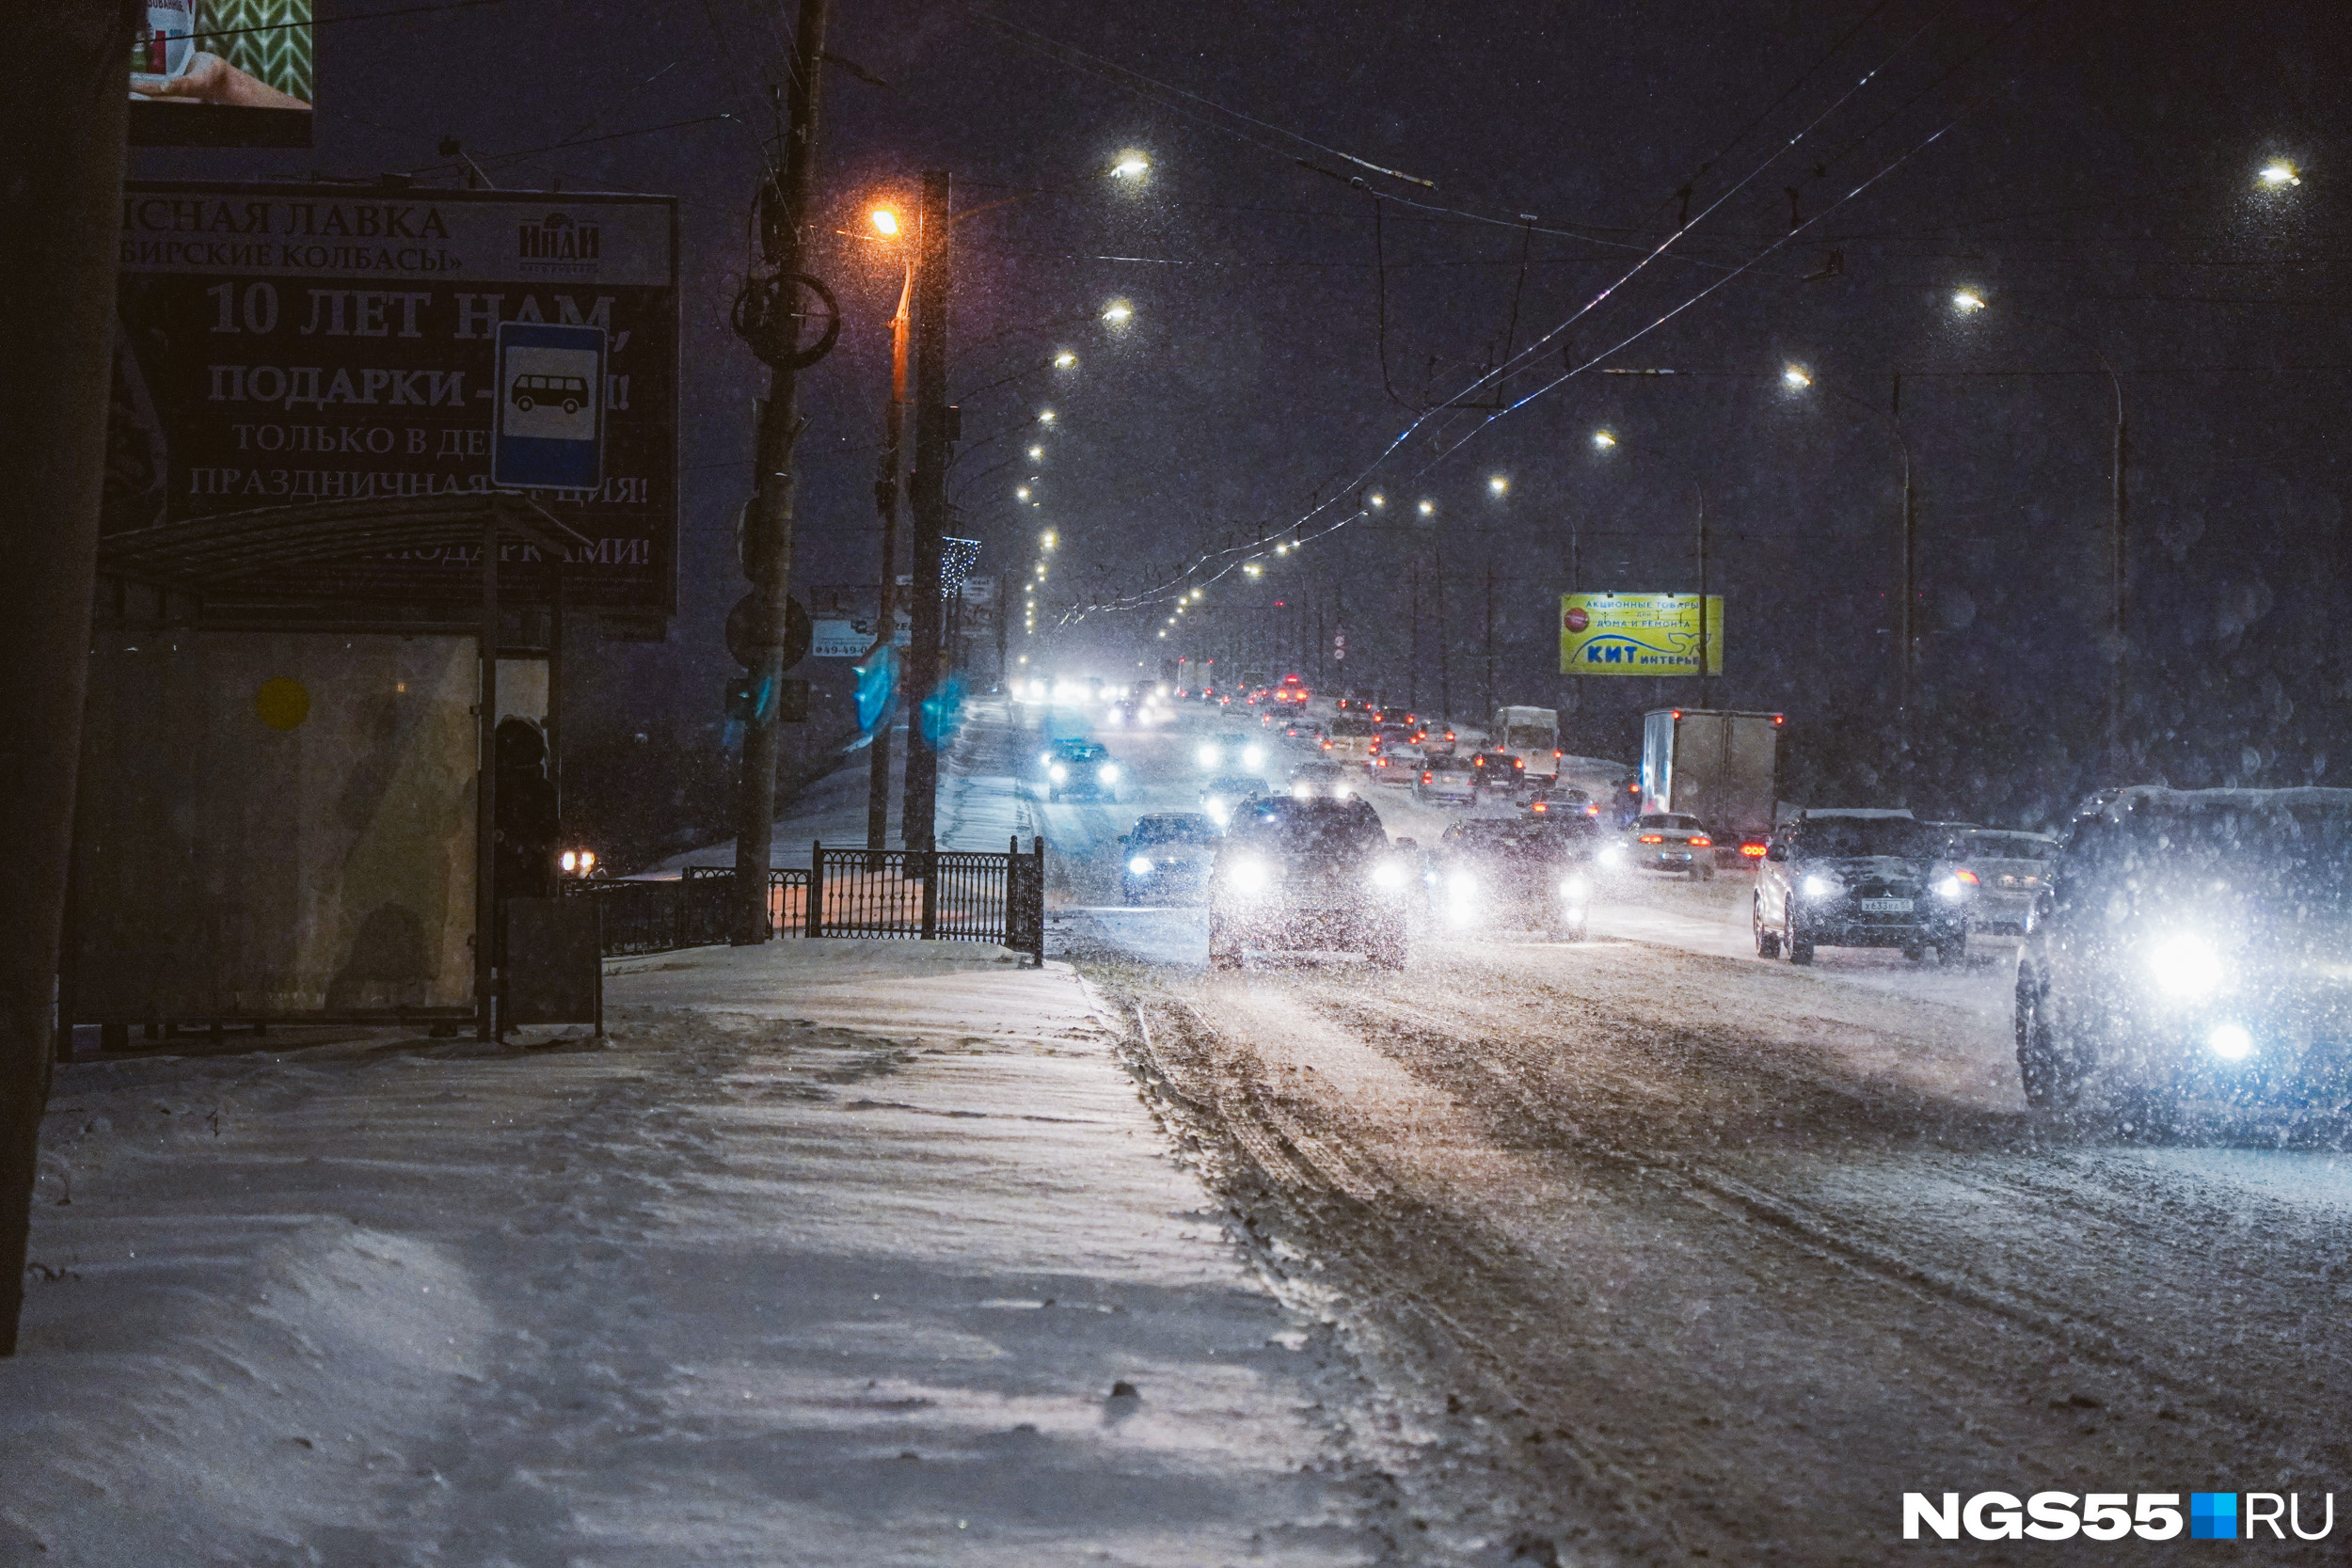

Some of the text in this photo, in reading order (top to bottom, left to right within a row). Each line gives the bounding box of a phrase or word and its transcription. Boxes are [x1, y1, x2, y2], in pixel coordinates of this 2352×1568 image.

[284, 203, 450, 239] ЛАВКА
[281, 245, 462, 272] КОЛБАСЫ»
[206, 281, 279, 335] 10
[299, 288, 432, 339] ЛЕТ
[206, 364, 466, 411] ПОДАРКИ
[231, 423, 394, 454] ТОЛЬКО
[406, 429, 427, 454] В
[1586, 600, 1700, 610] АКЦИОННЫЕ ТОВАРЫ
[1597, 620, 1628, 628] ДОМА
[1642, 620, 1691, 628] РЕМОНТА
[1587, 645, 1700, 665] КИТ ИНТЕРЬЕ
